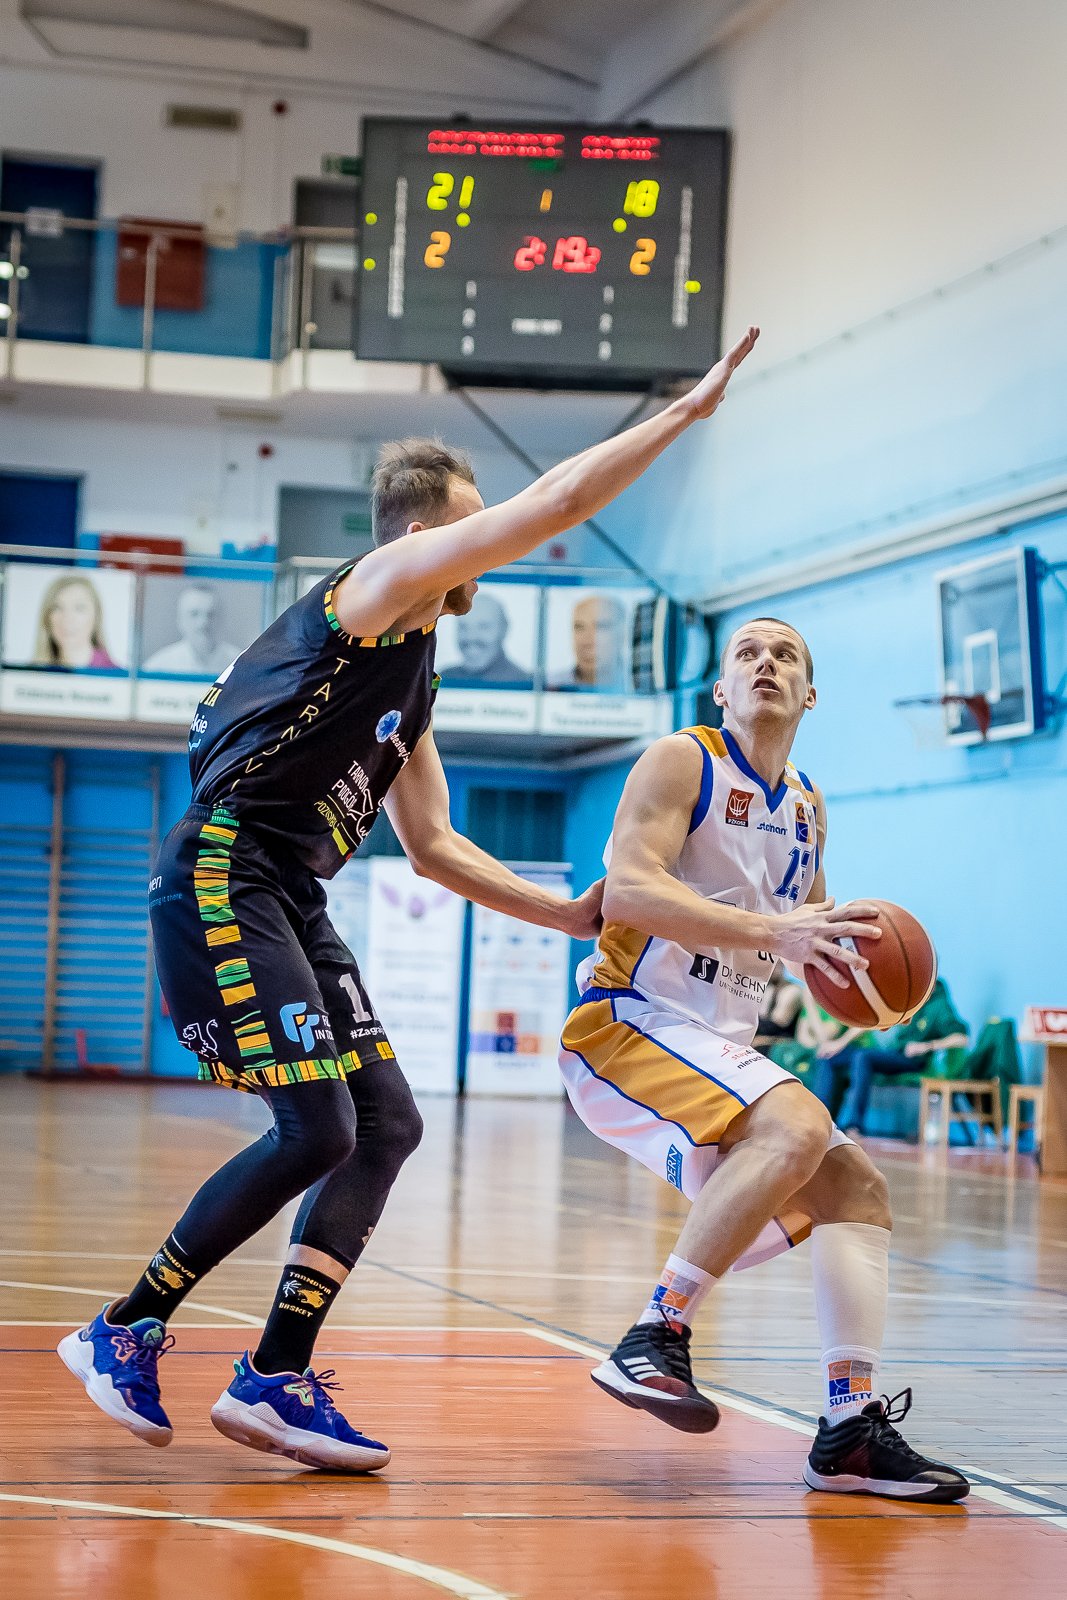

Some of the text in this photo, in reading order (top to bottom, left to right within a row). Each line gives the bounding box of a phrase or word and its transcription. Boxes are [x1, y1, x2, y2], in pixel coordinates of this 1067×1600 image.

[426, 172, 475, 211] 21
[623, 179, 660, 218] 18
[424, 230, 451, 269] 2
[629, 238, 657, 276] 2
[289, 1271, 332, 1295] TARNOVIA
[278, 1302, 314, 1318] BASKET
[829, 1391, 873, 1408] SUDETY
